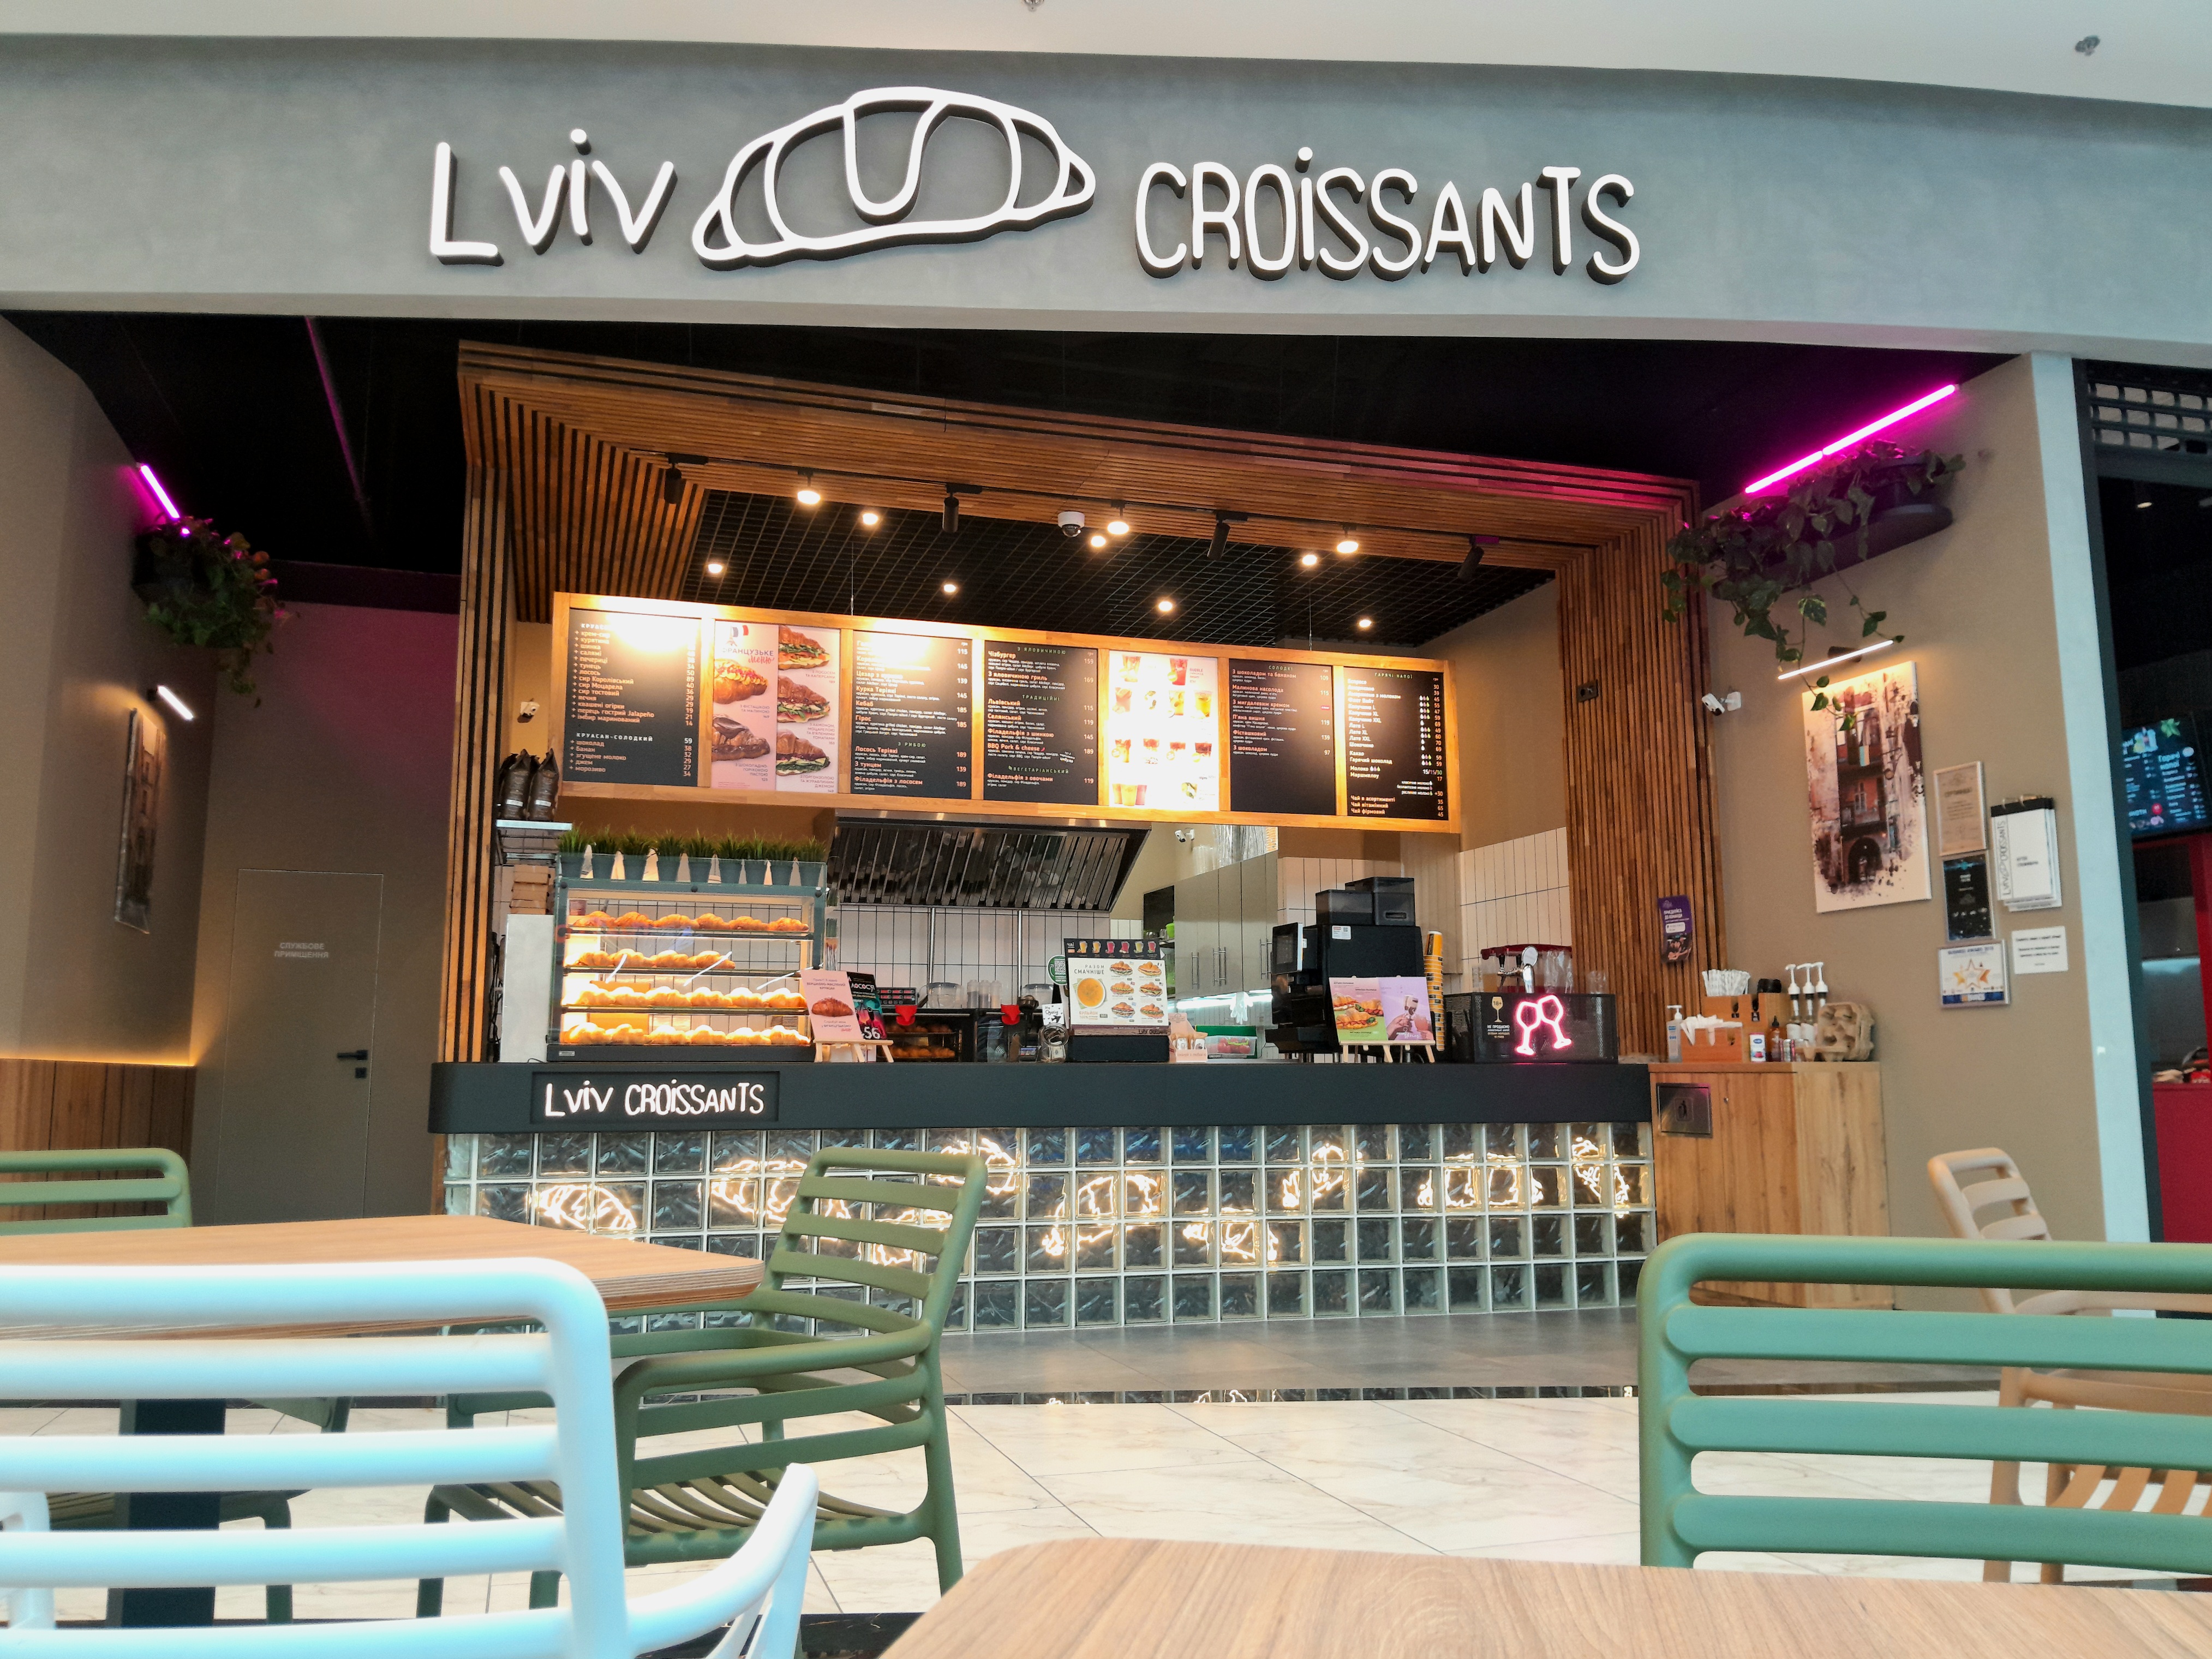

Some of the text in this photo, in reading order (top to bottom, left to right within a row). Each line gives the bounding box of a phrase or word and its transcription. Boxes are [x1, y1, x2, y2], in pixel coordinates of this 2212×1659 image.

[988, 651, 1016, 659] Чізбургер
[988, 728, 1025, 736] Філадельфія
[577, 733, 653, 742] КРУАСАН-СОЛОДКИЙ
[854, 776, 893, 784] Філадельфія
